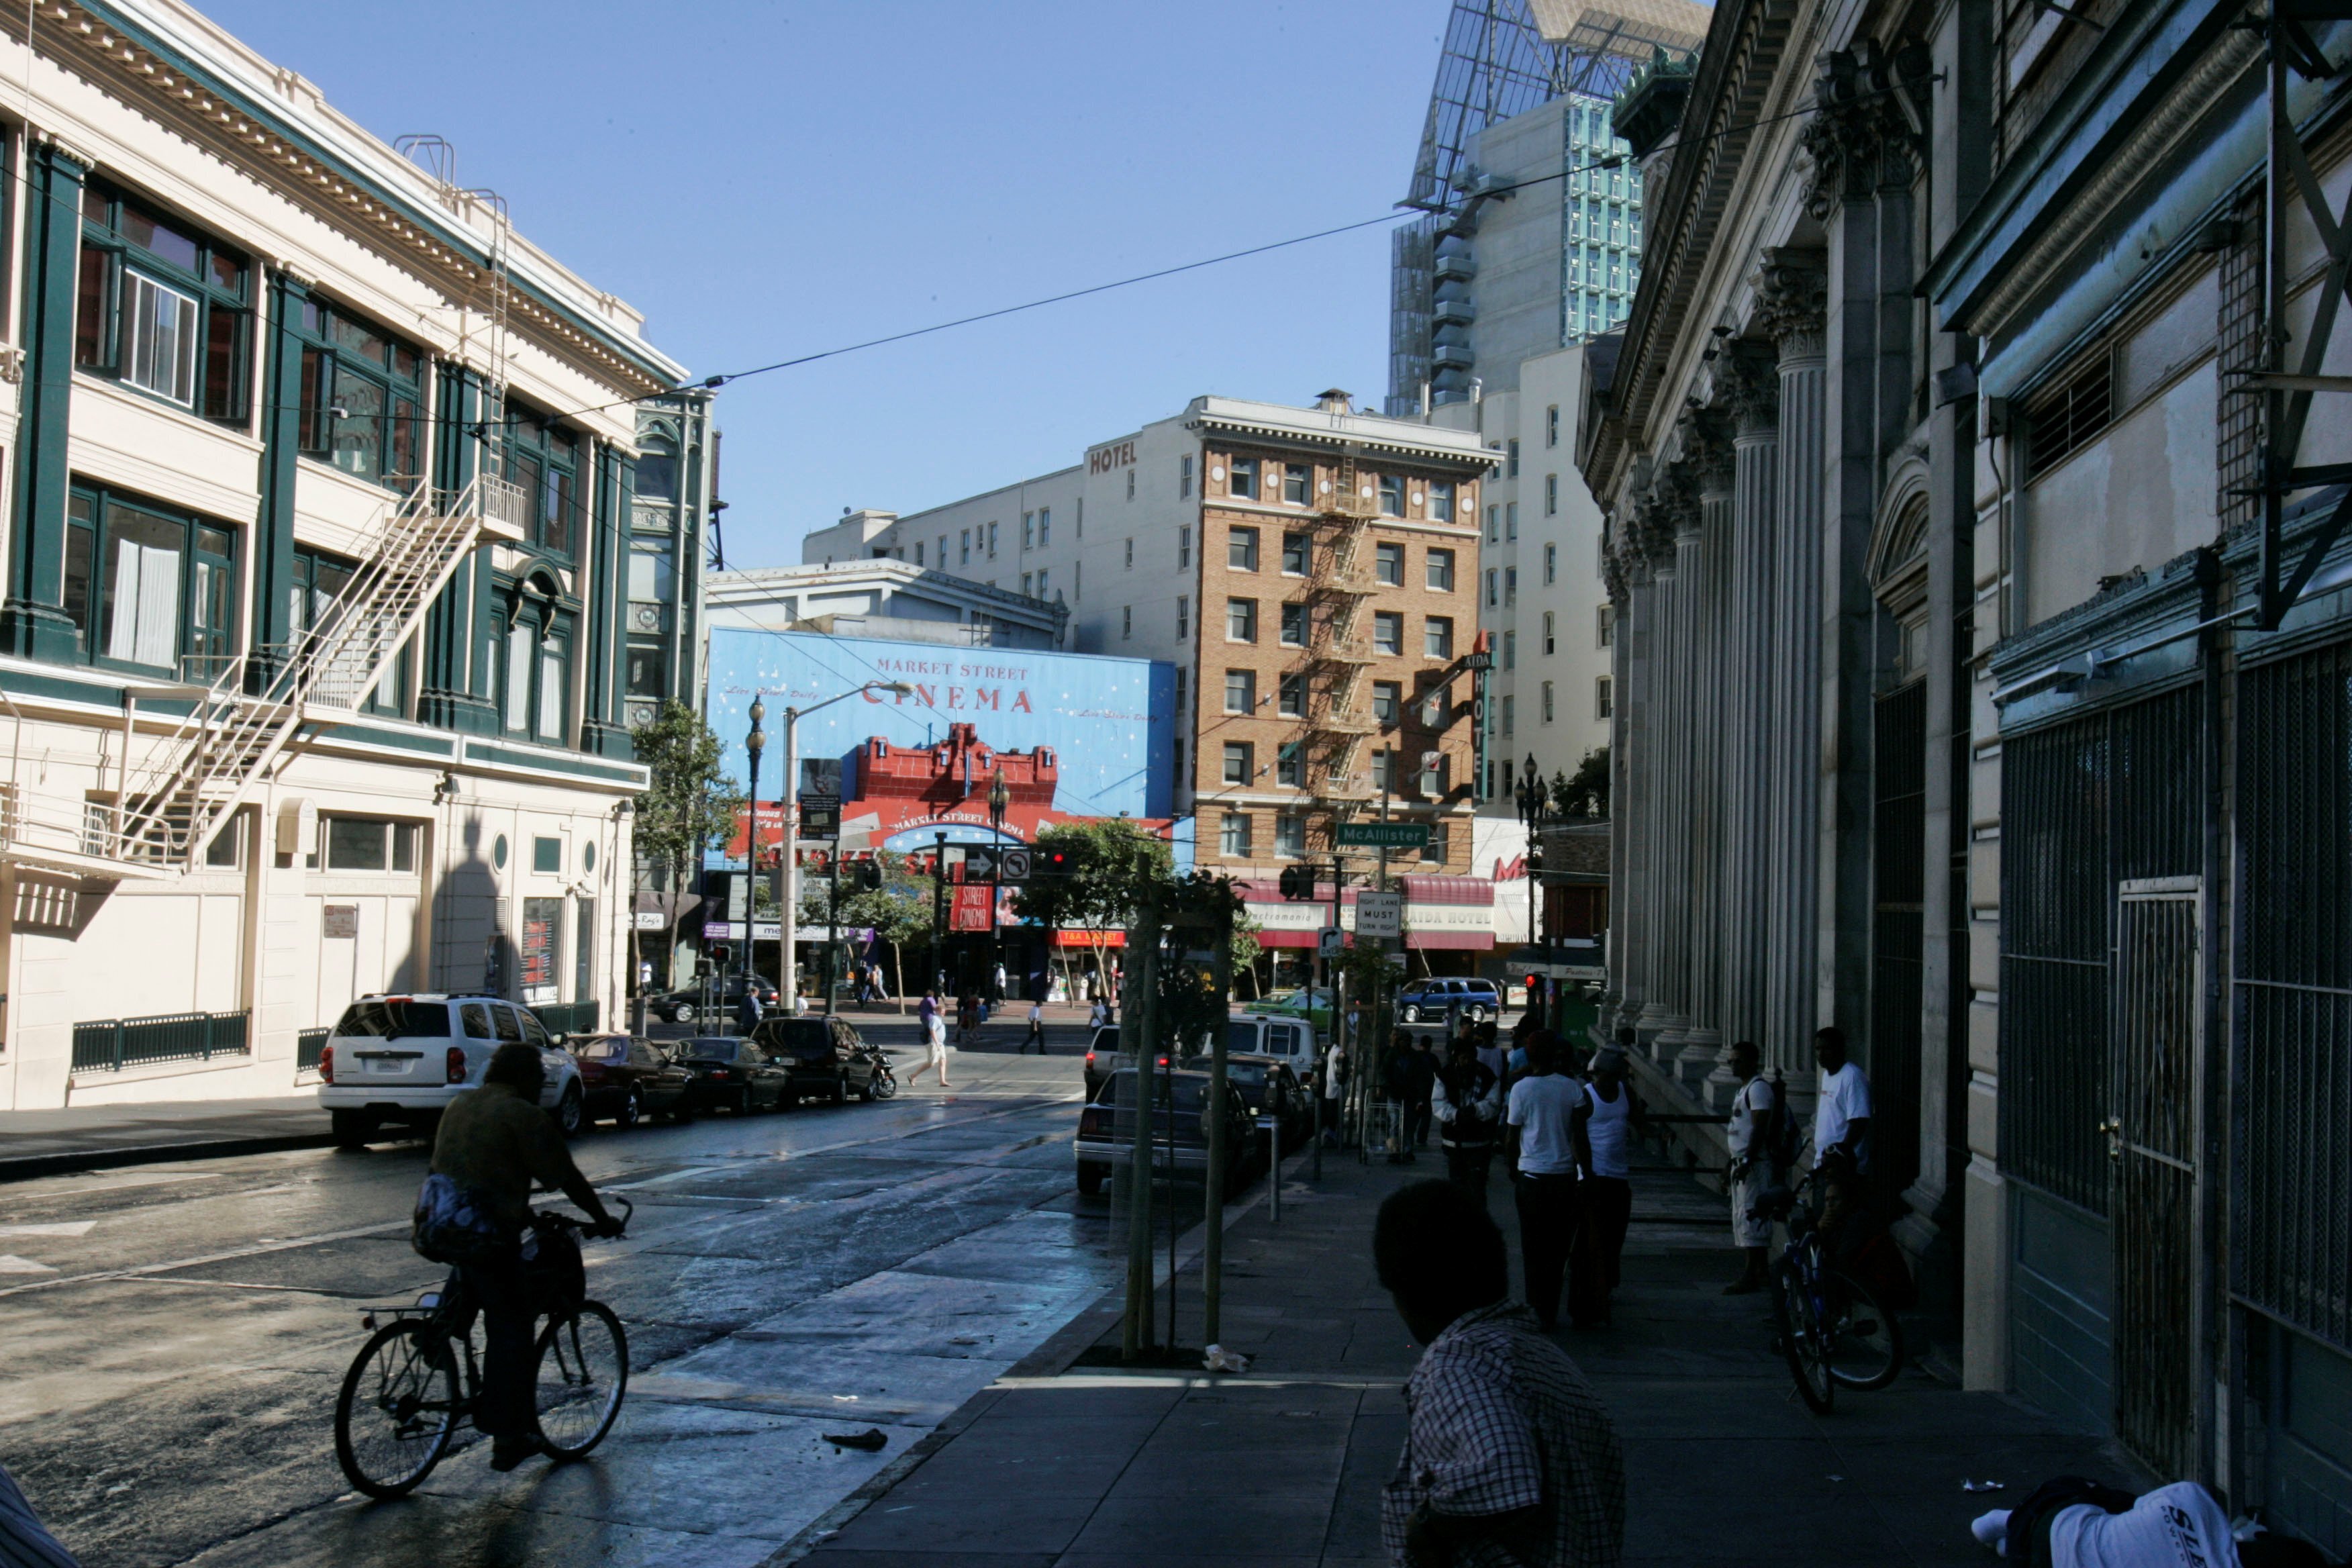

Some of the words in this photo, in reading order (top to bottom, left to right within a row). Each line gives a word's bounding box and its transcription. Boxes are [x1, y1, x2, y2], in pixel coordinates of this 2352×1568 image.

[1090, 441, 1137, 476] HOTEL
[877, 658, 953, 675] MARKET
[960, 664, 1028, 681] STREET
[1465, 654, 1489, 667] AIDA
[1473, 671, 1484, 799] HOTEL
[893, 812, 939, 832] MARKET
[942, 812, 983, 823] STREET
[986, 816, 1025, 838] CNEMA
[1343, 828, 1421, 842] McAllister
[963, 886, 987, 905] STREET
[960, 908, 987, 927] CINEMA
[1364, 910, 1393, 919] MUST
[1410, 912, 1442, 923] AIDA
[1448, 912, 1491, 924] HOTEL
